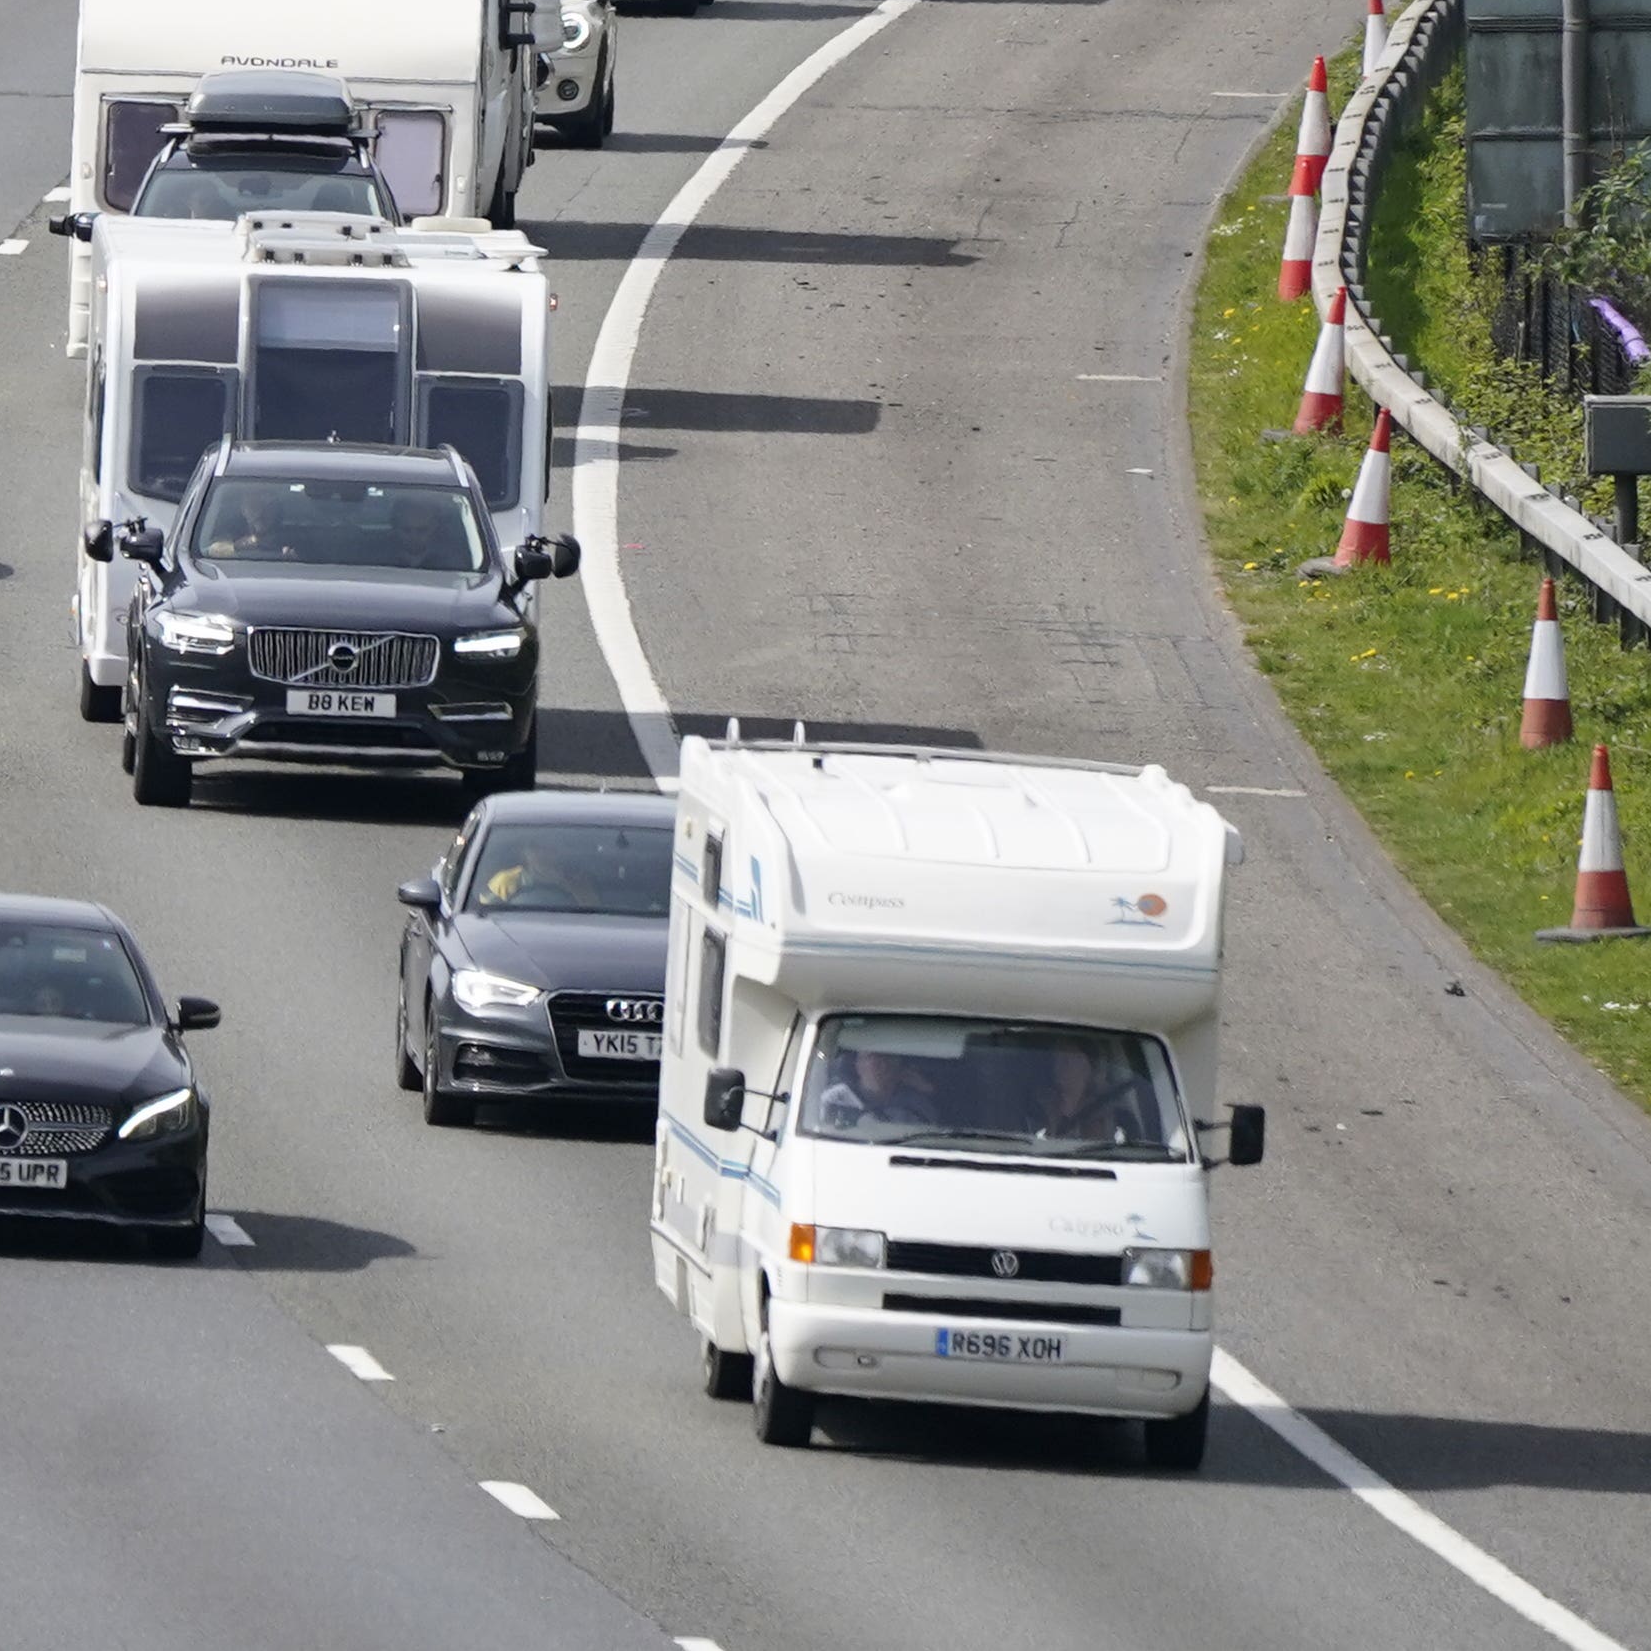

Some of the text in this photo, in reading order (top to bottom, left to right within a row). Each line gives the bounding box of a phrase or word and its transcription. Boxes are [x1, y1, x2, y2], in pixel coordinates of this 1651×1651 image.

[220, 55, 339, 69] AVONDALE
[307, 694, 333, 711] B8
[593, 1033, 639, 1054] YK15
[18, 1163, 61, 1184] UPR
